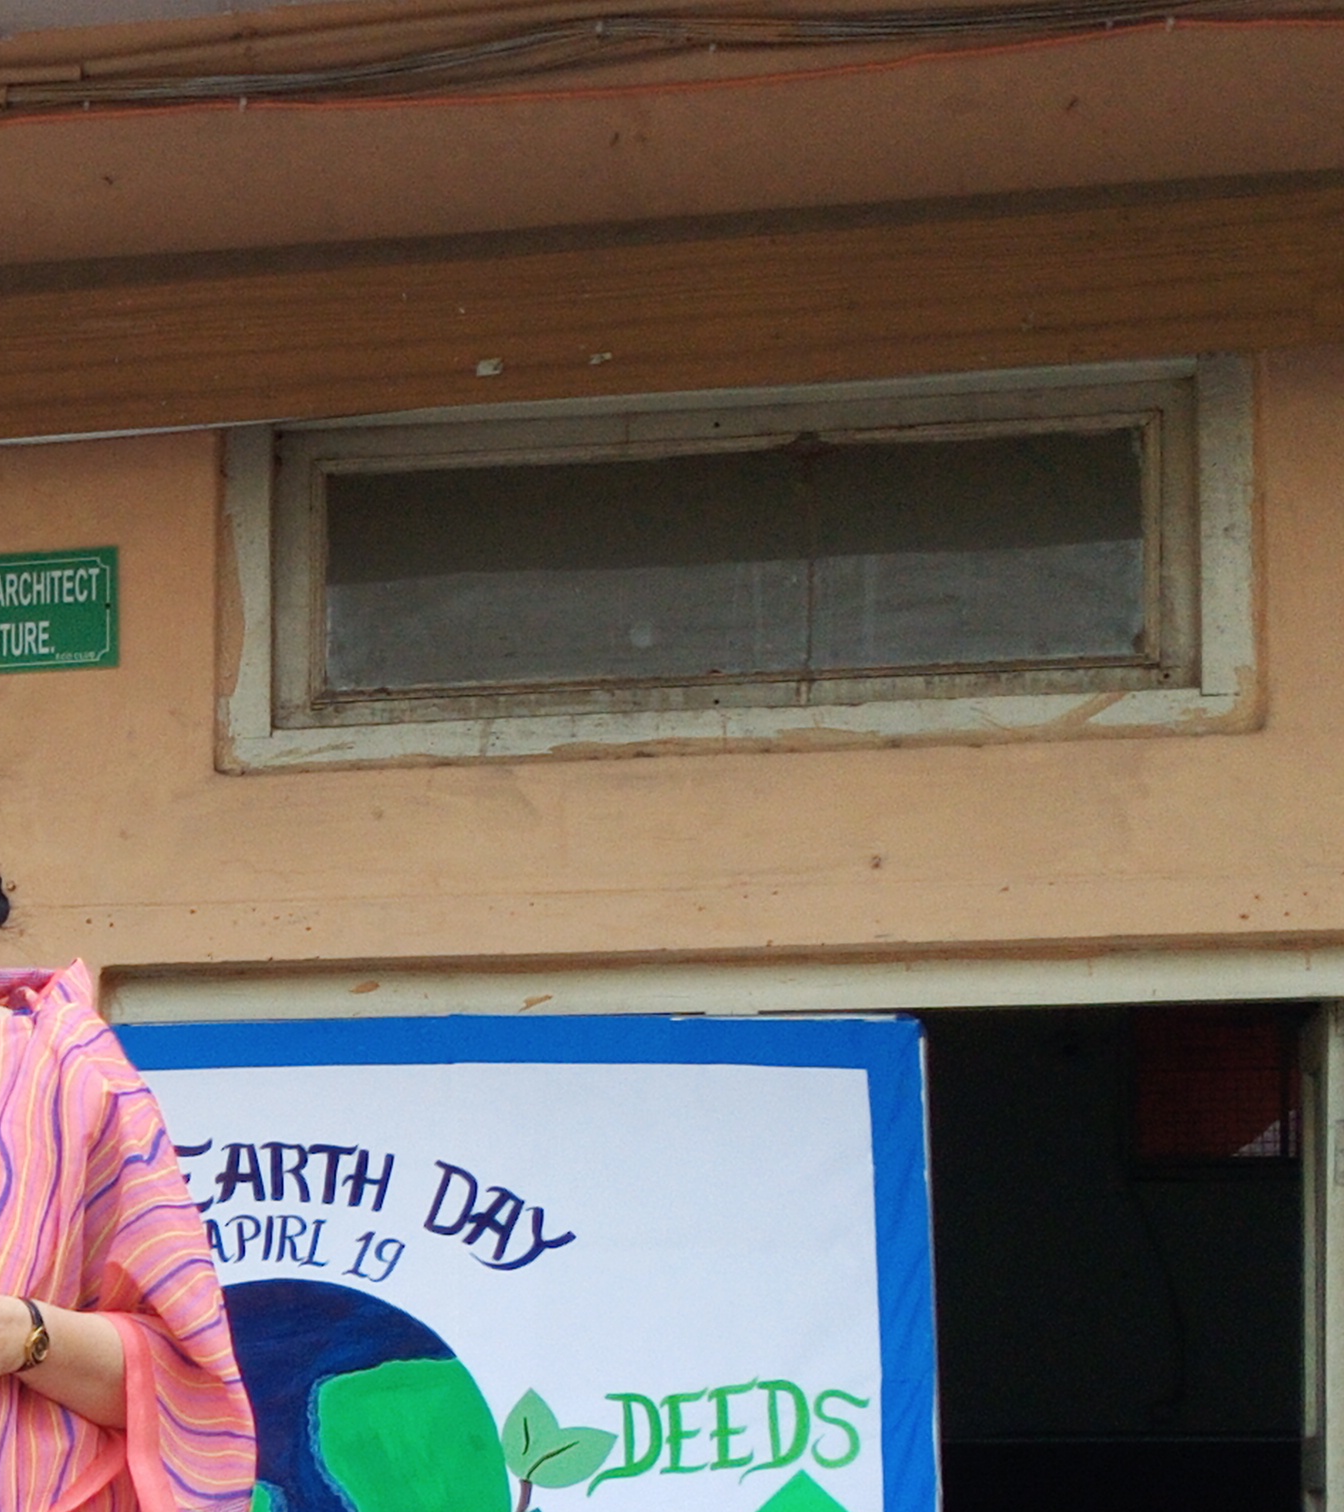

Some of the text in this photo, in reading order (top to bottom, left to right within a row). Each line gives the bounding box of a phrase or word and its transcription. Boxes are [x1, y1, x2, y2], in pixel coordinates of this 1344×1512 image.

[342, 1231, 406, 1282] 19
[423, 1160, 576, 1271] DAY
[588, 1376, 870, 1498] DEEDS
